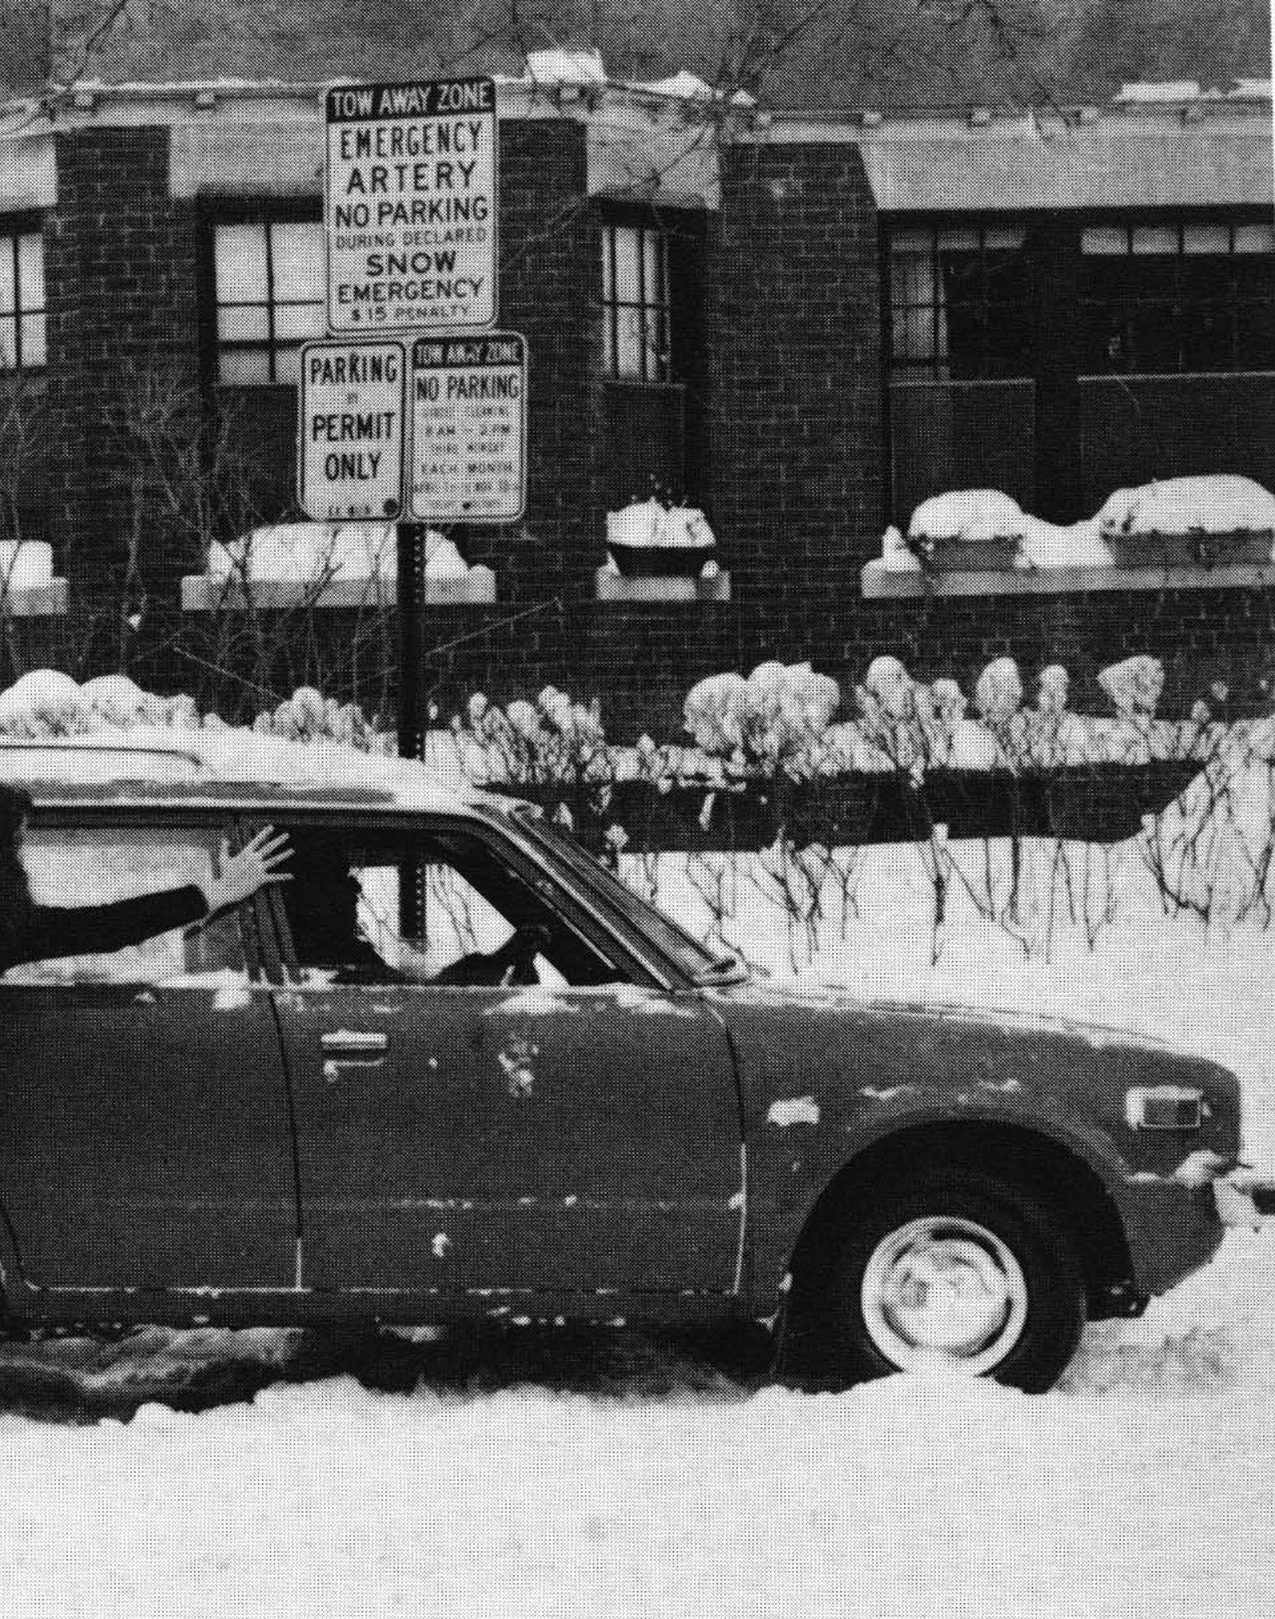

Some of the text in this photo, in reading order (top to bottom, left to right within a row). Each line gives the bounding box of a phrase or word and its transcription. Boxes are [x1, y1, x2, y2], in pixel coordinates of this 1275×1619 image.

[332, 82, 491, 118] TOW AWAY ZONE
[341, 122, 482, 159] EMERGENCY
[347, 161, 475, 194] ARTERY
[336, 196, 488, 228] NO PARKING
[336, 227, 487, 250] DURING DECLARED
[366, 250, 456, 276] SNOW
[338, 277, 484, 304] EMERGENCY
[394, 305, 471, 320] PENALTY
[311, 353, 397, 385] PARKING
[417, 373, 520, 401] NO PARKING
[312, 412, 396, 441] PERMIT
[325, 452, 382, 481] ONLY
